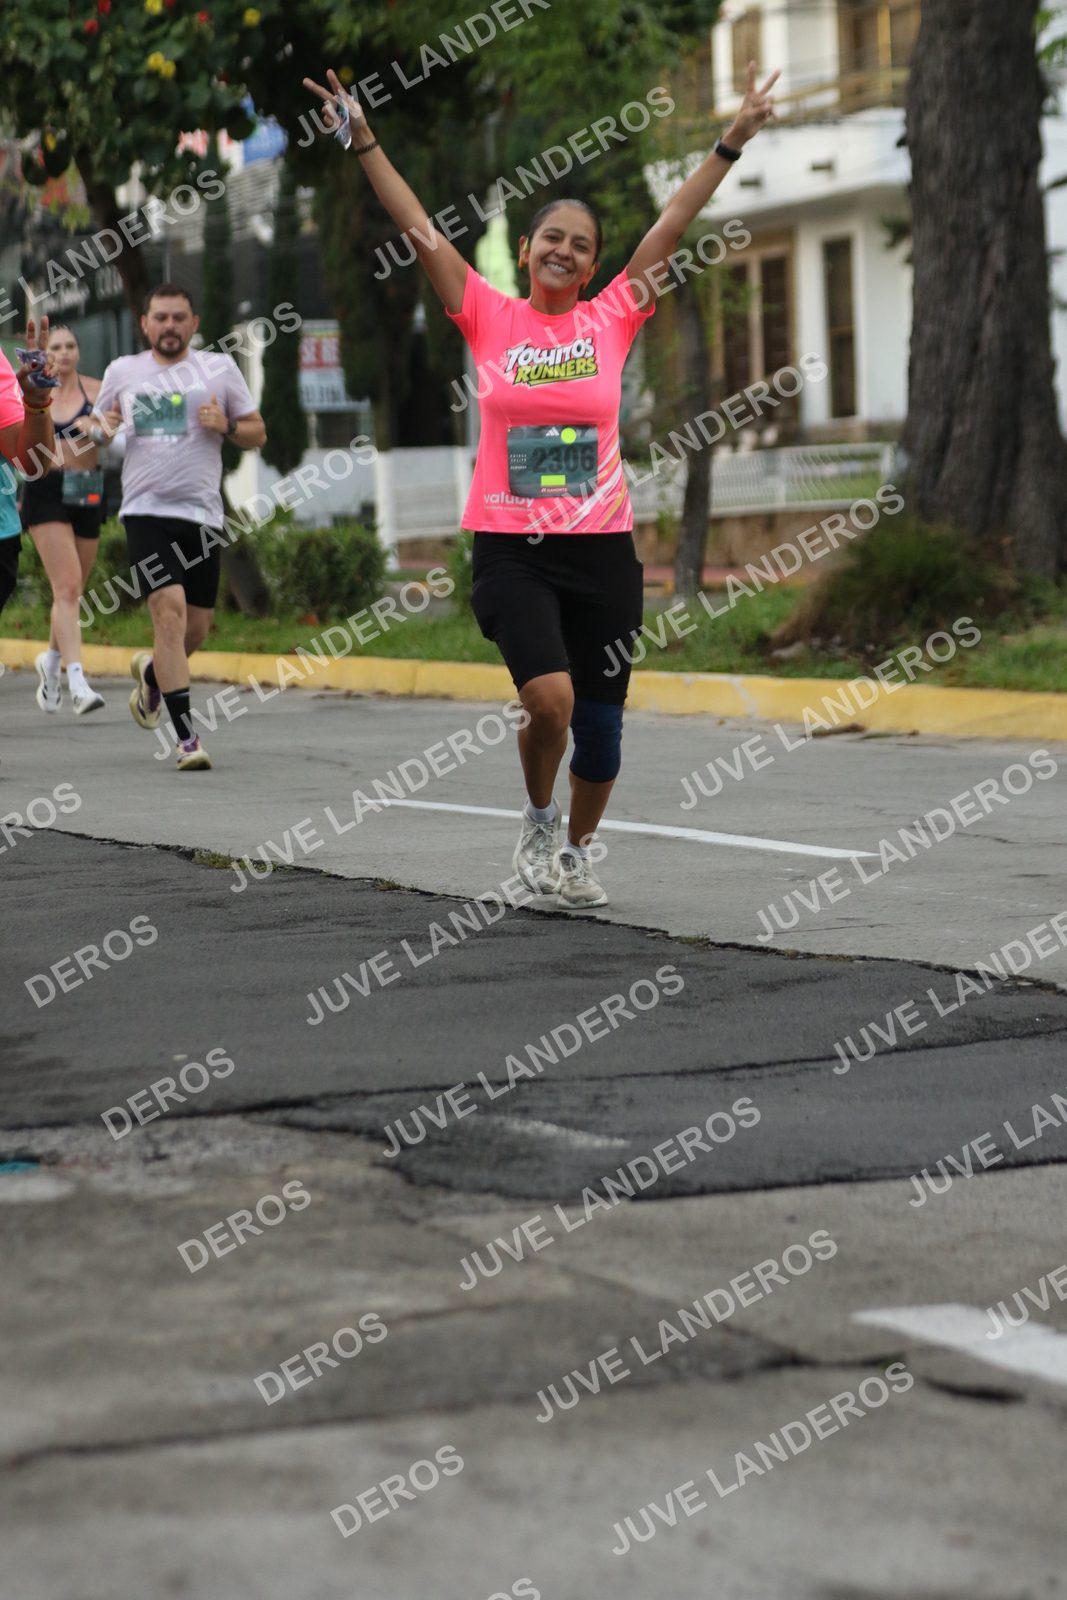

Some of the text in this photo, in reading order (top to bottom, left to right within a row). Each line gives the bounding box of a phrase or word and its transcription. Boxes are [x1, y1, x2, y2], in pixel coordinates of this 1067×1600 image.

[504, 336, 596, 374] TOCHITOS
[511, 356, 598, 385] RUNNERS
[532, 444, 595, 473] 2306
